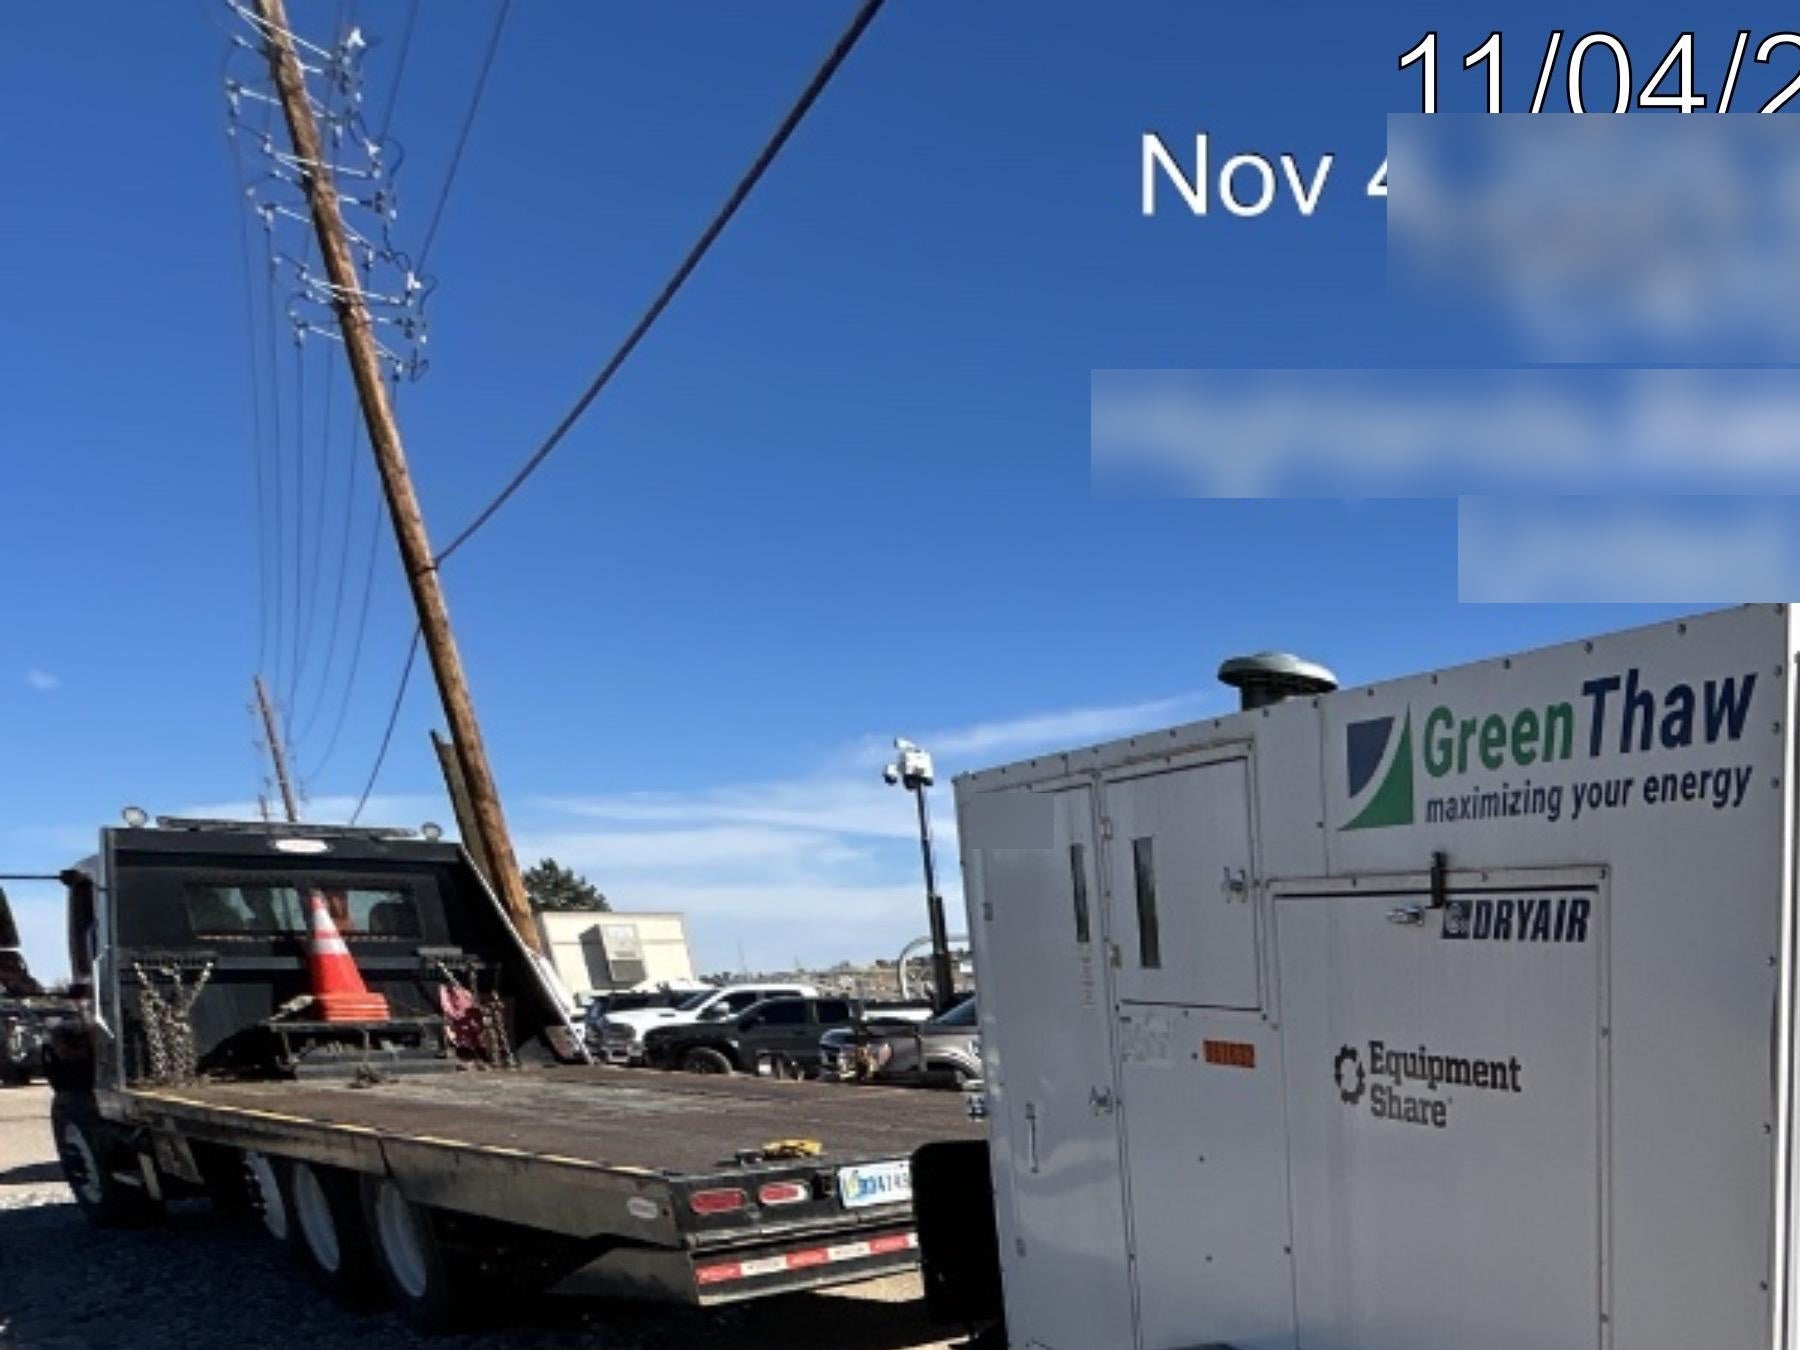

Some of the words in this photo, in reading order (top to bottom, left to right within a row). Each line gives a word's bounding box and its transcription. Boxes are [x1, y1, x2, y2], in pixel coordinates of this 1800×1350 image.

[1425, 784, 1562, 823] maximizing
[1571, 777, 1634, 819] your
[1643, 764, 1753, 809] energy
[1472, 897, 1591, 943] DRYAIR
[1368, 1040, 1522, 1092] Equipment
[1370, 1083, 1447, 1128] Share
